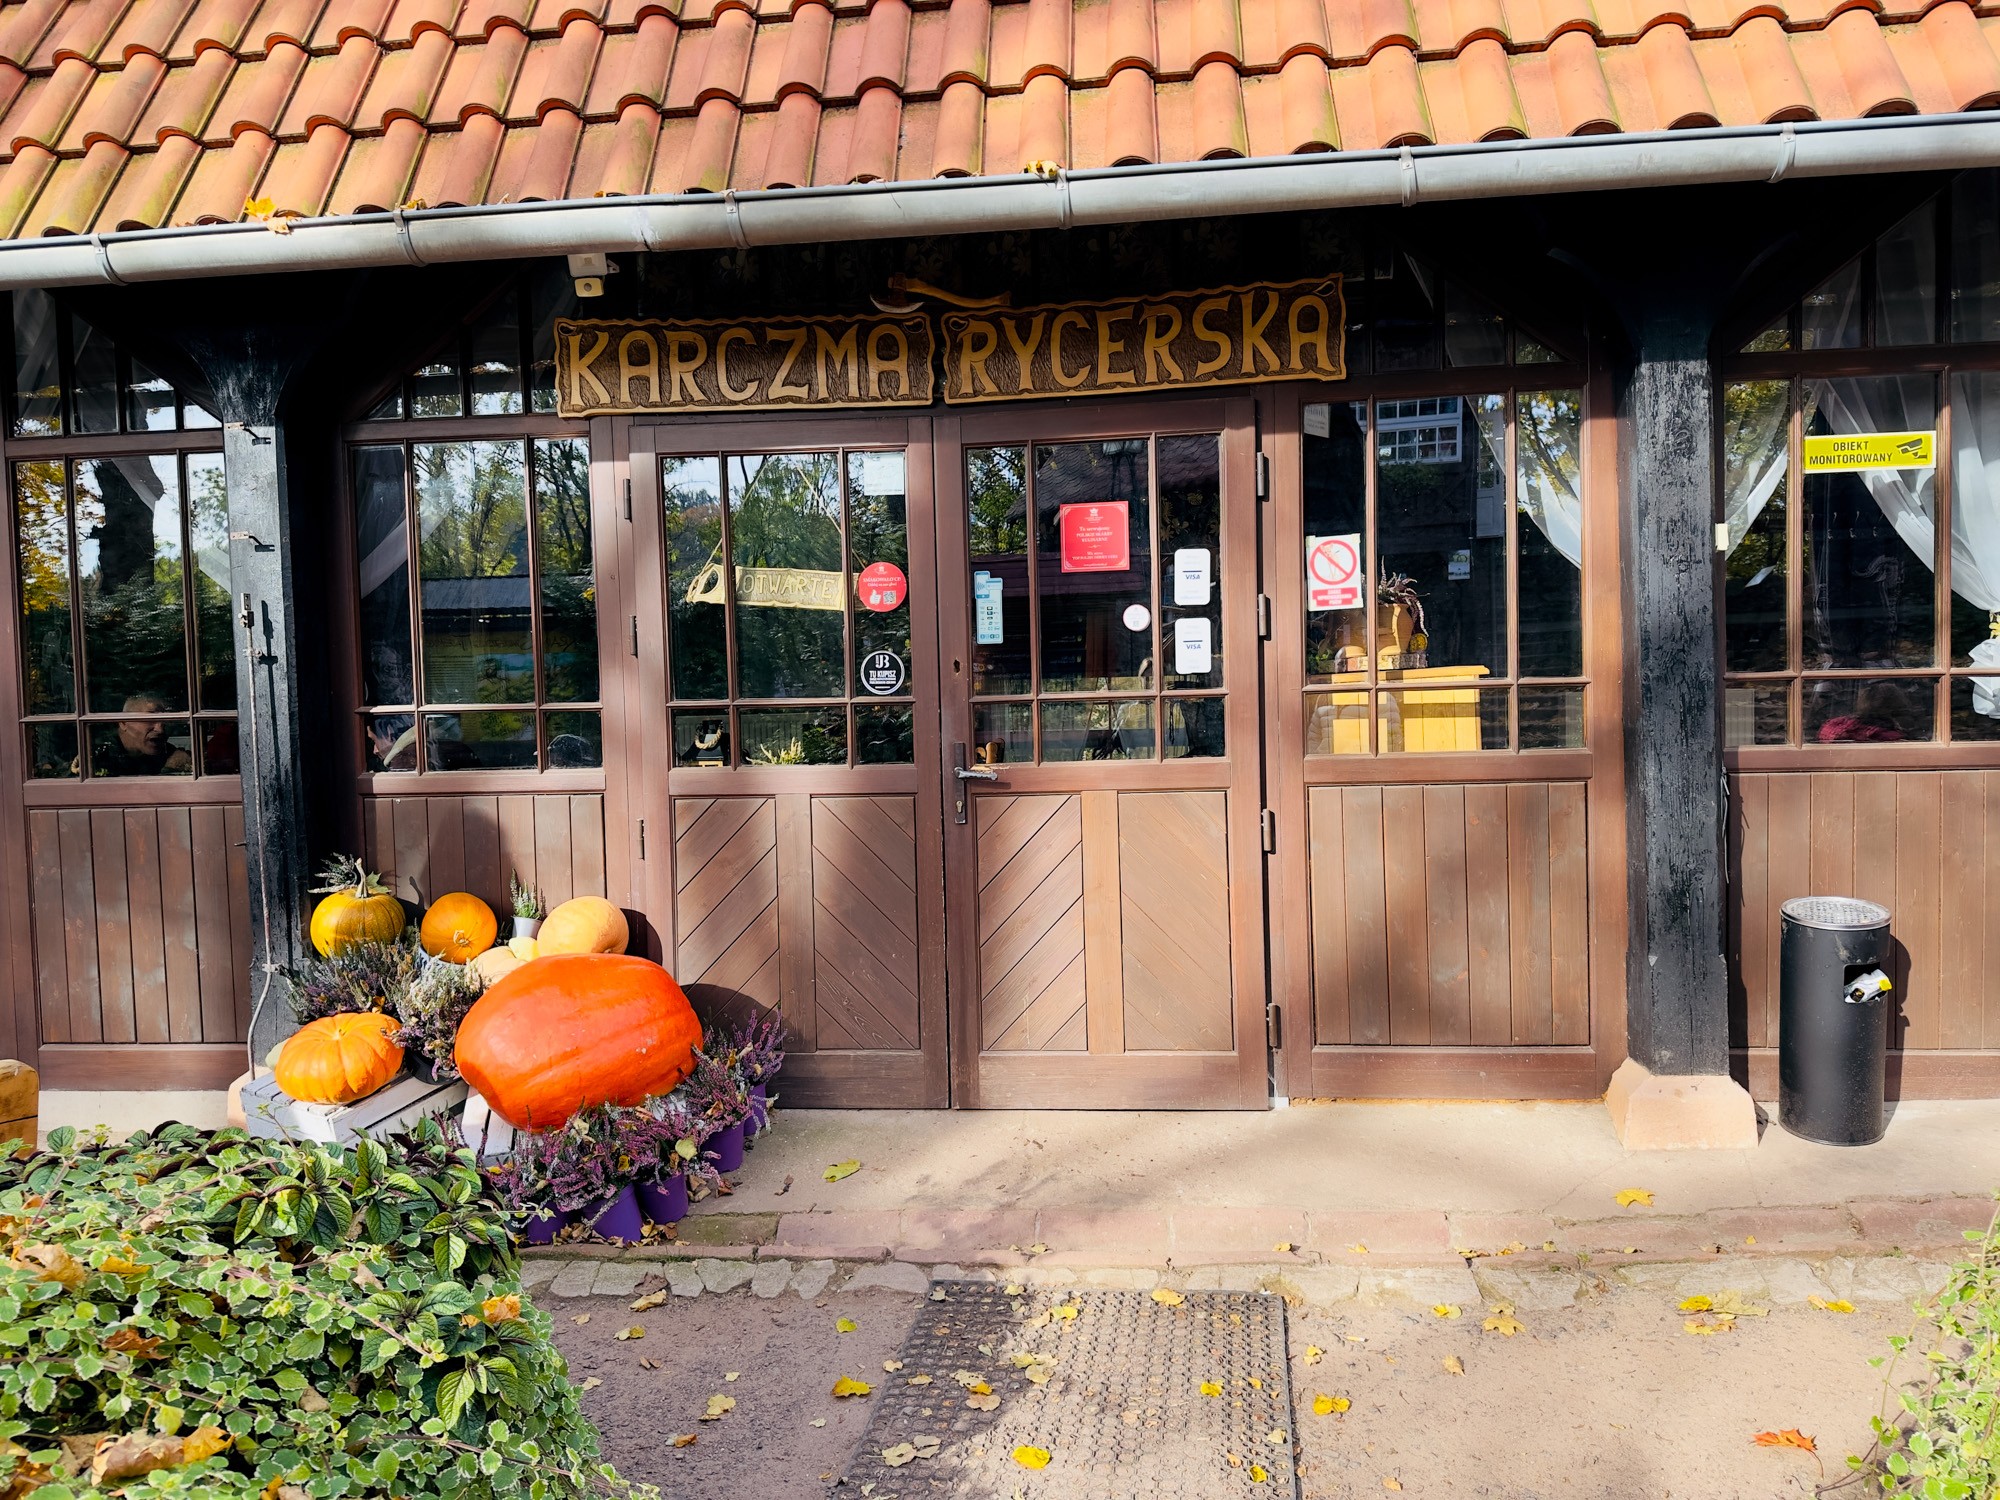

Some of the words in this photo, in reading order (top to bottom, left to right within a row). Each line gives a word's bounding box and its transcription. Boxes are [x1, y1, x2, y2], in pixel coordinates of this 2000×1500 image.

[568, 323, 909, 406] KARCZMA
[956, 290, 1339, 398] RYCERSKA
[1833, 441, 1869, 451] OBIEKT
[1809, 453, 1893, 465] MONITOROWANY
[743, 574, 836, 600] OTWARTE
[877, 670, 896, 678] KUPISZ
